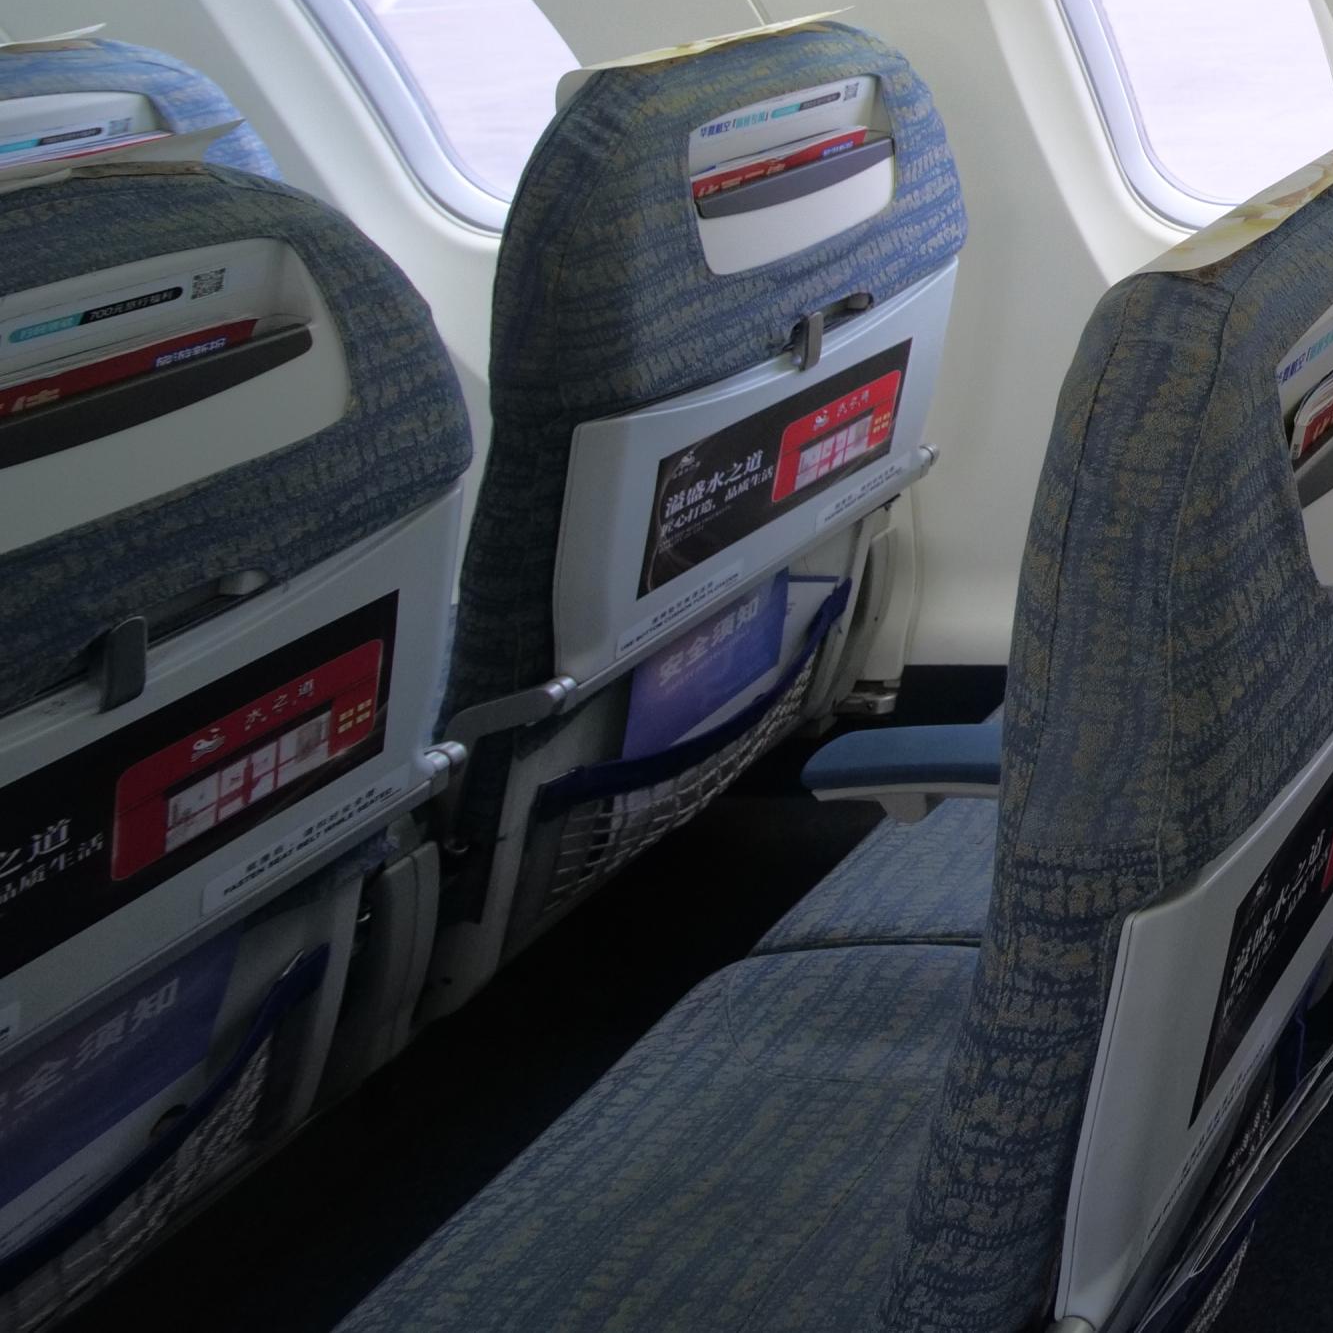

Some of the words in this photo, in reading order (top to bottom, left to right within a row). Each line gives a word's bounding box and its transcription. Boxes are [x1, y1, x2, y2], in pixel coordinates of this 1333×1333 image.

[660, 593, 760, 687] 安全须知
[0, 977, 180, 1111] 全须知
